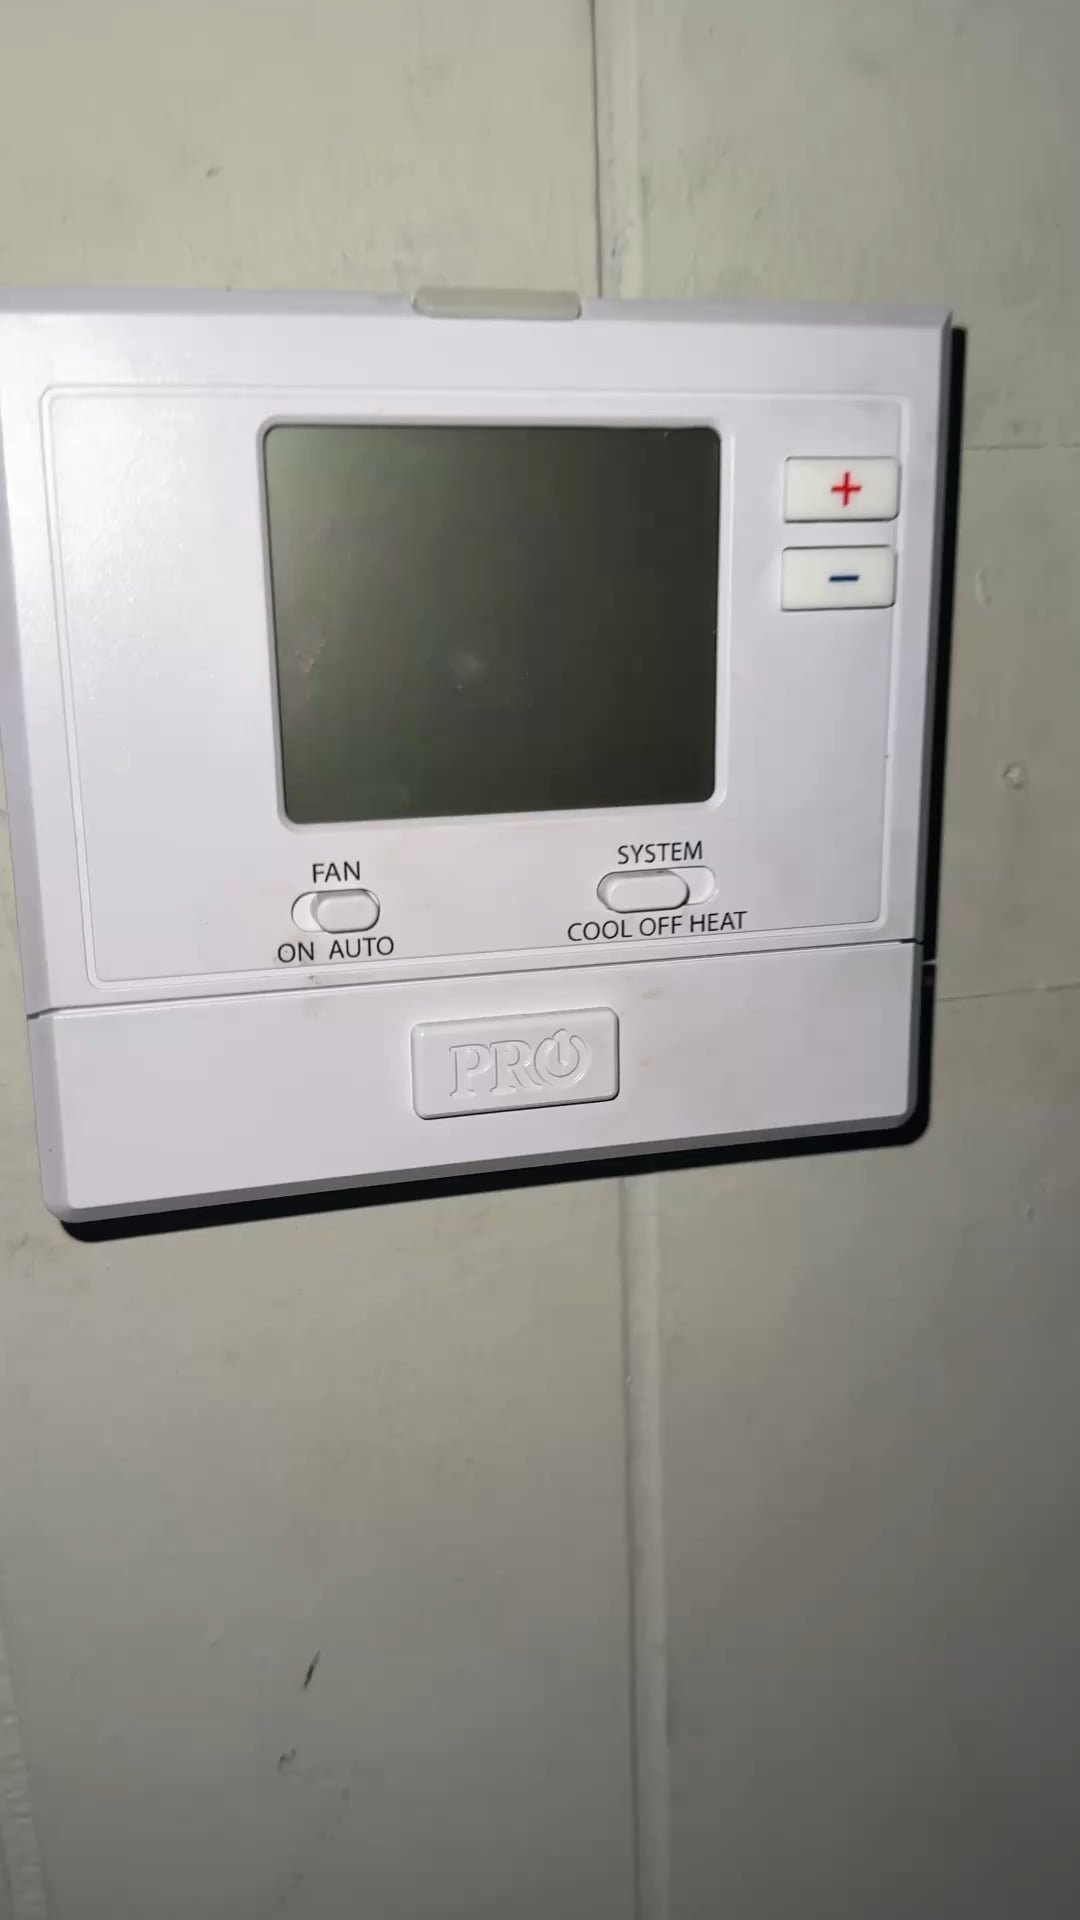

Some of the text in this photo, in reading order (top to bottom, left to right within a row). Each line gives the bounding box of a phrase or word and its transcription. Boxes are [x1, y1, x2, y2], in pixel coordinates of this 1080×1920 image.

[617, 840, 704, 865] SYSTEM
[312, 860, 361, 884] FAN
[567, 910, 749, 942] COOL OFF HEAT
[277, 935, 395, 963] ON AUTO
[448, 1028, 592, 1098] PRO
